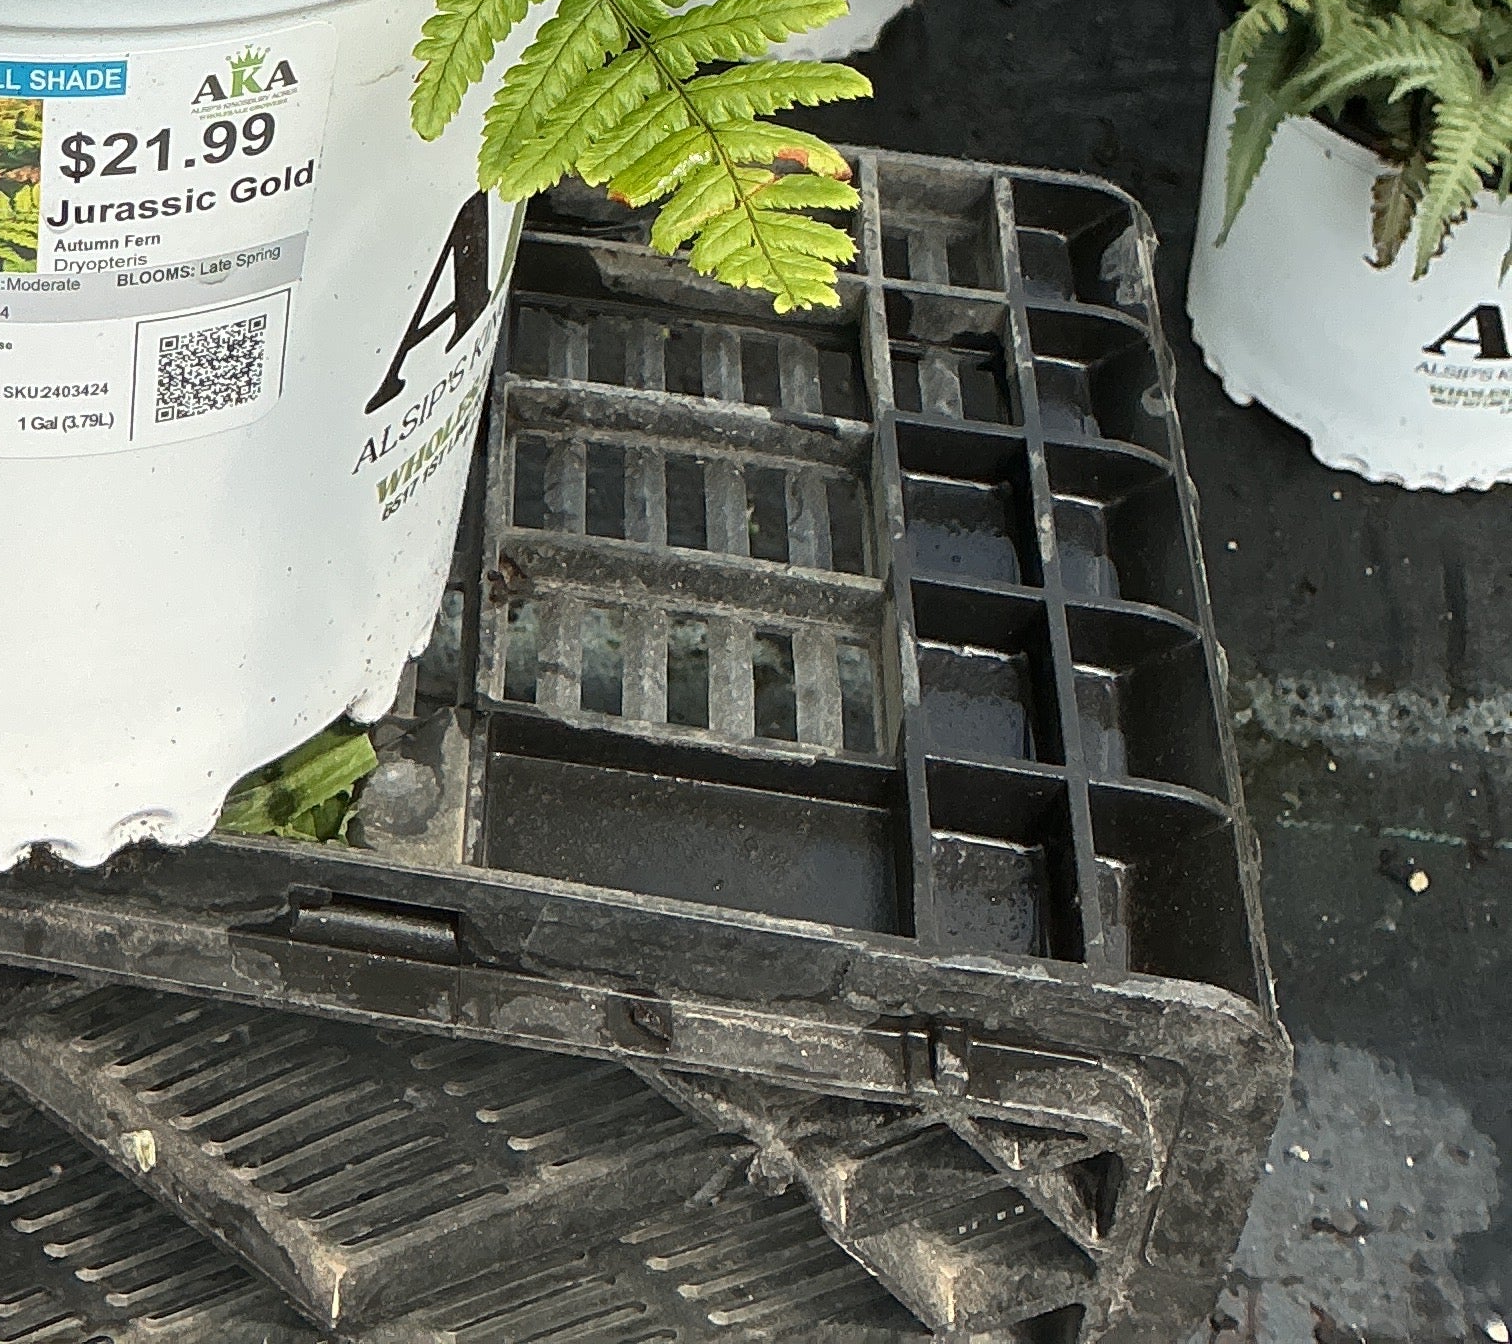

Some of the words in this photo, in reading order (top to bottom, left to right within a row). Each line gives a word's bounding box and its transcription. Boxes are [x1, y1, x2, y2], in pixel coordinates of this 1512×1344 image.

[30, 66, 123, 91] SHADE
[191, 59, 299, 105] AKA
[59, 112, 276, 184] $21.99
[46, 188, 217, 227] Jurassic
[230, 159, 315, 204] Gold
[54, 235, 119, 253] Autumn
[124, 233, 161, 249] Fern
[54, 254, 148, 275] Dryopteris
[117, 266, 196, 288] BLOOMS:
[200, 259, 232, 276] Late
[236, 245, 281, 269] Spring
[0, 305, 10, 320] 4
[365, 187, 526, 415] A
[18, 415, 26, 432] 1
[31, 413, 58, 431] Gal
[62, 412, 115, 434] (3.79L)
[351, 354, 467, 476] ALSIP'S
